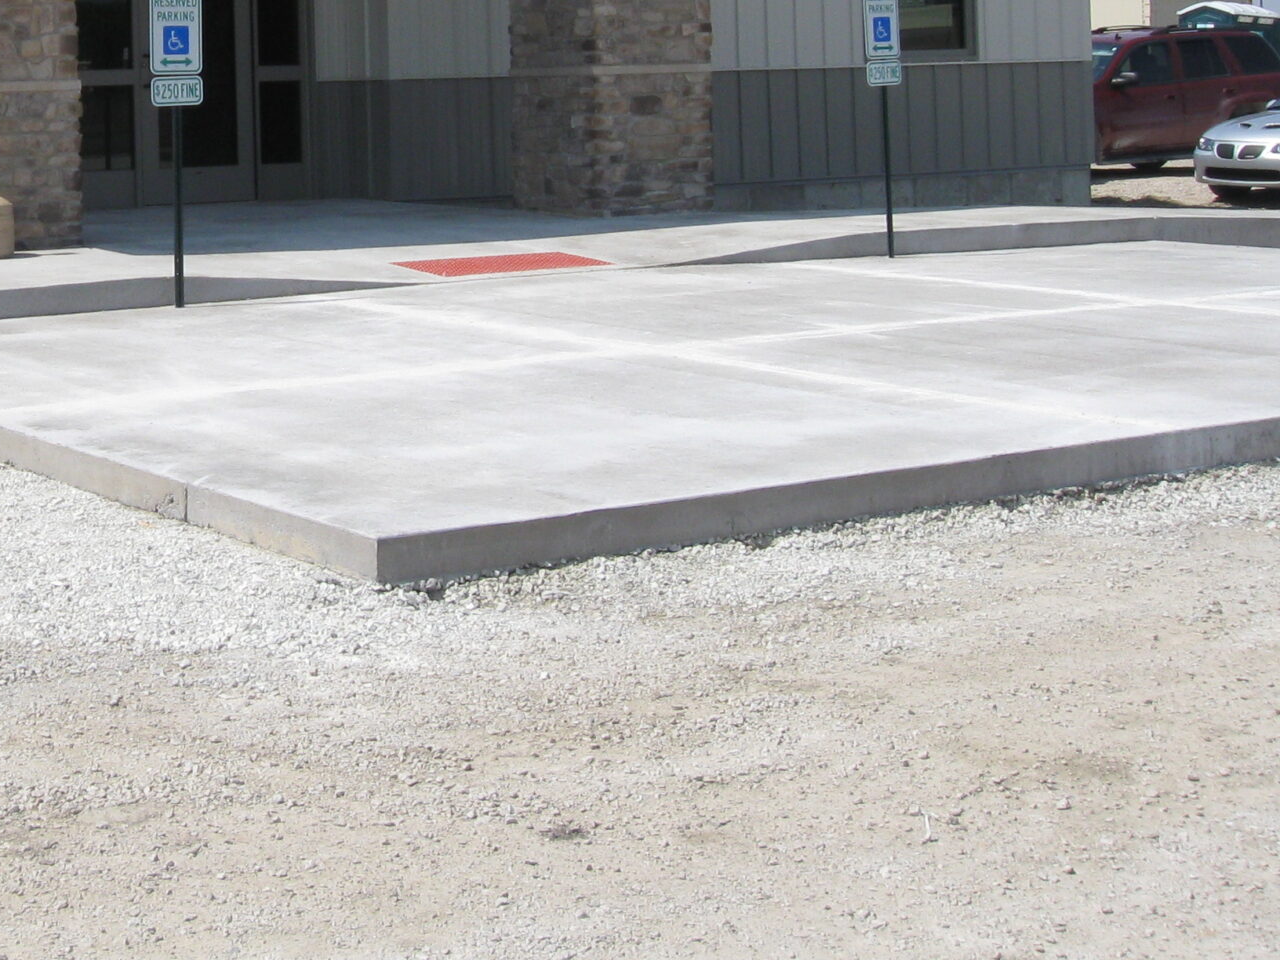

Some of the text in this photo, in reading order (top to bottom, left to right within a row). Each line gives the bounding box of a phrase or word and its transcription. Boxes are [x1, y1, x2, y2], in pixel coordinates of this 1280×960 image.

[157, 11, 195, 22] PARKING
[155, 82, 199, 99] $250 FINE
